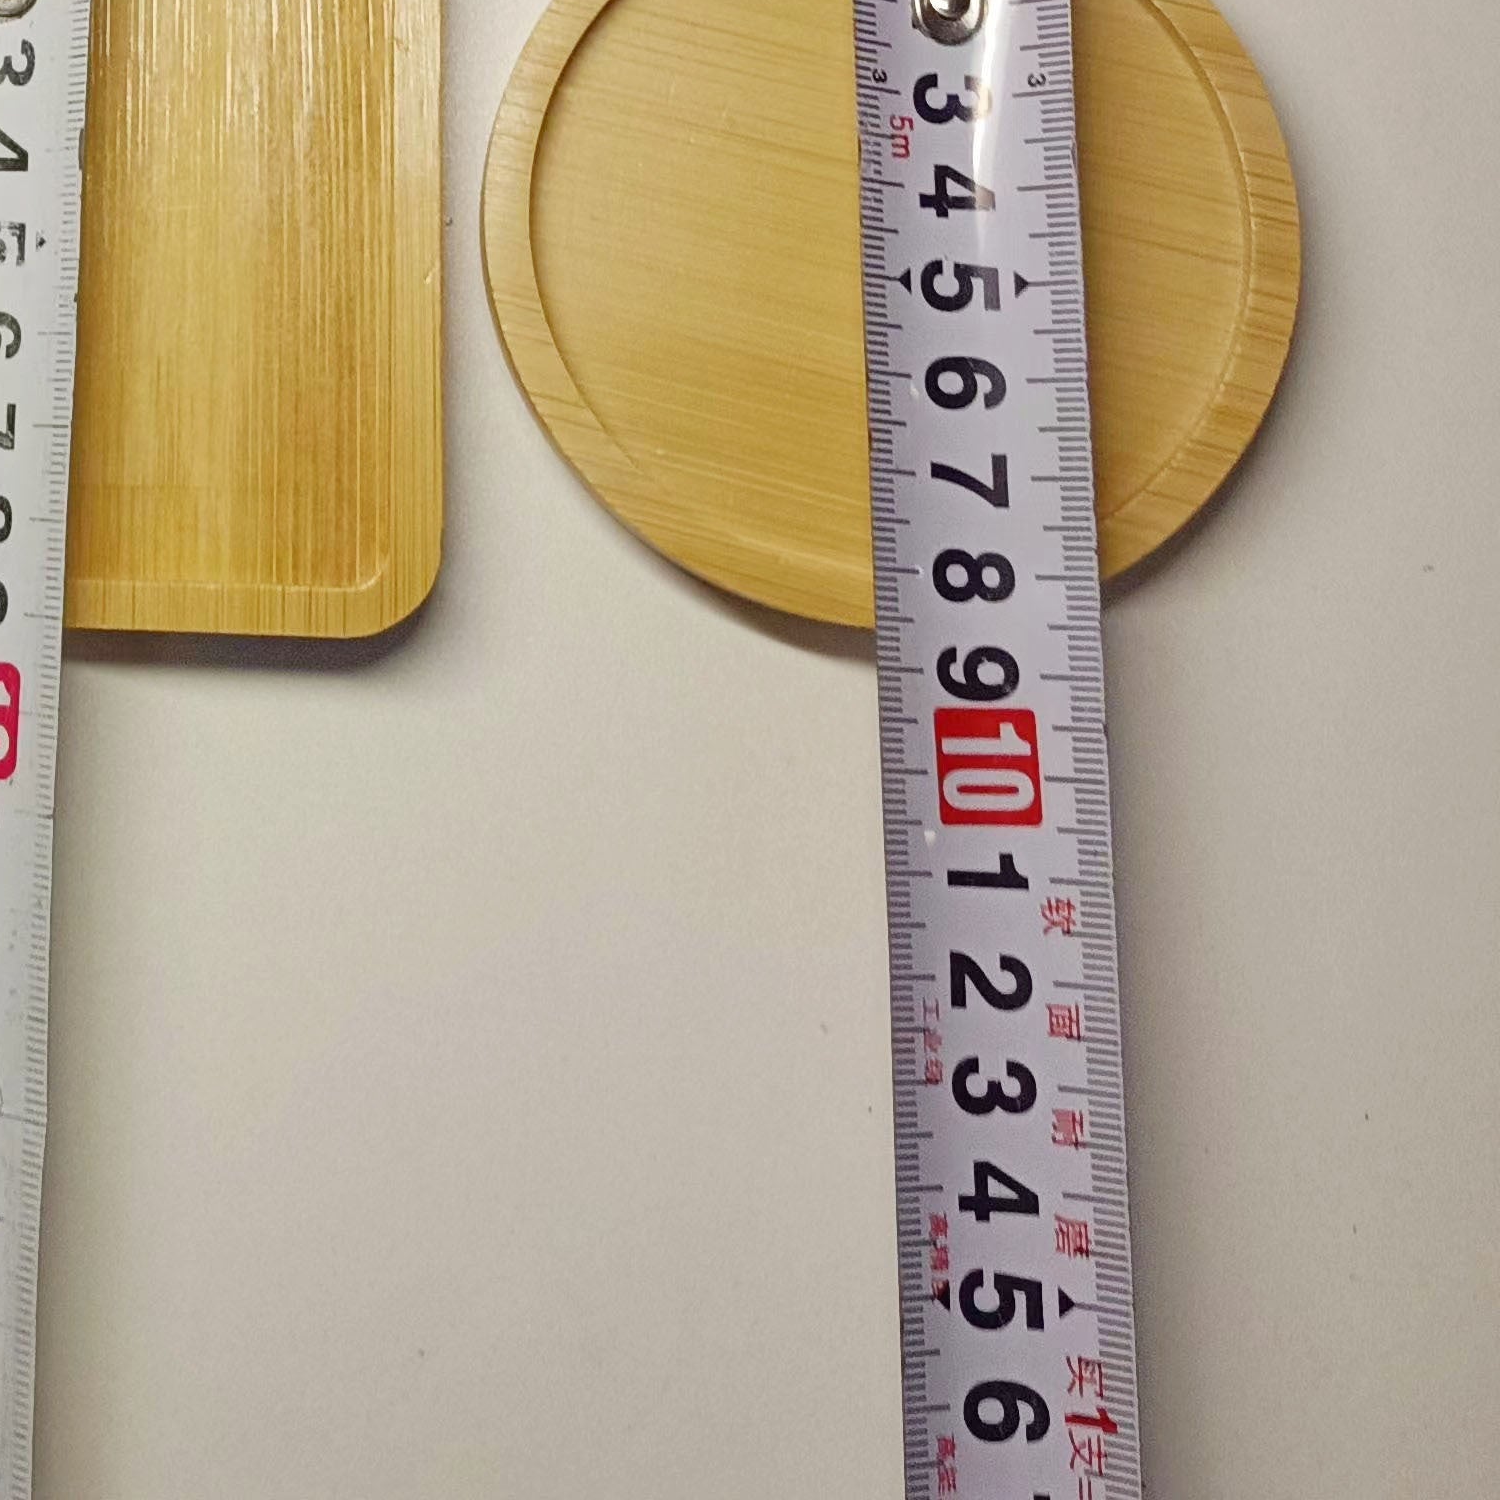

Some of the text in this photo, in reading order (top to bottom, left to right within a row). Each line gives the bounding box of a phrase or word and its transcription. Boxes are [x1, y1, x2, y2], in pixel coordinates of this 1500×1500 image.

[872, 68, 887, 84] 3
[1027, 72, 1046, 88] 3
[890, 115, 914, 159] 5m
[912, 73, 1051, 1444] 3 4 5 6 7 8 9 10 1 2 3 4 5 6
